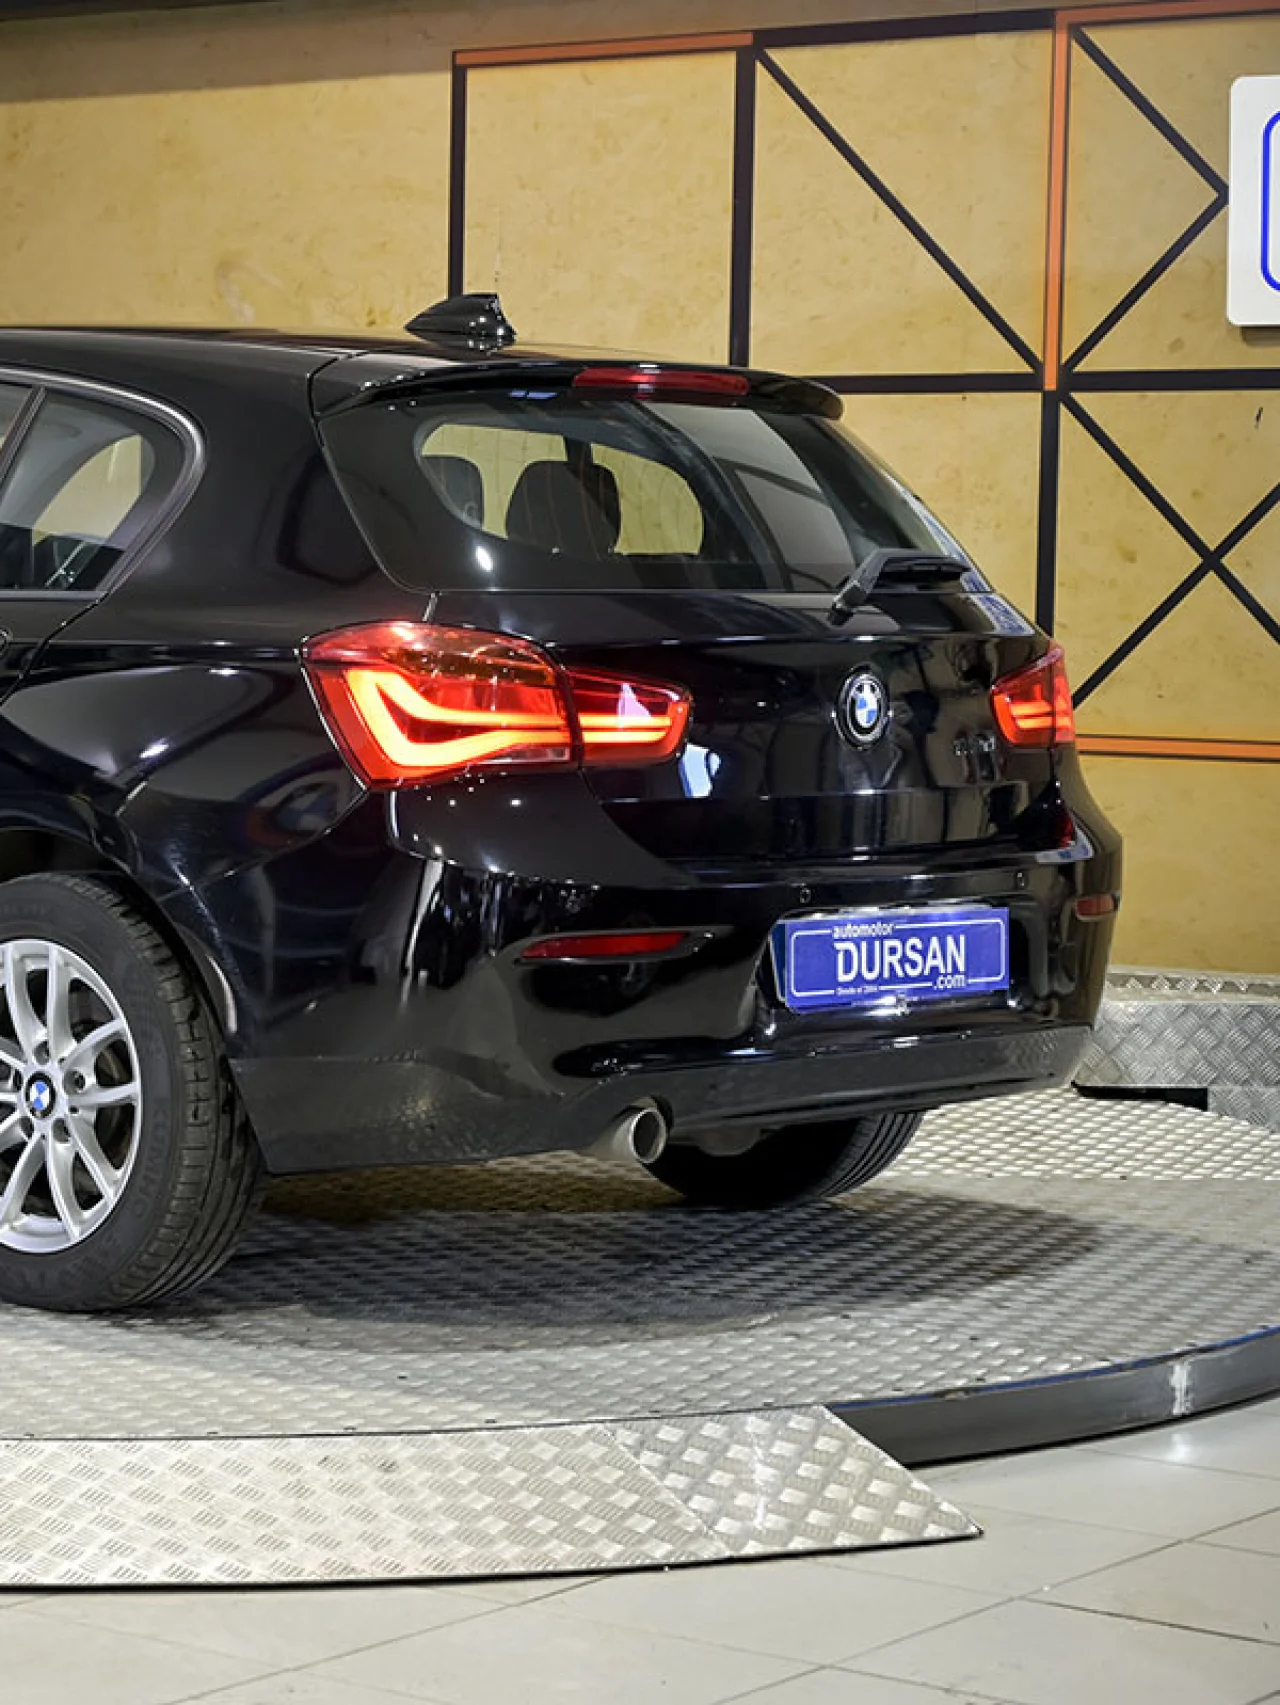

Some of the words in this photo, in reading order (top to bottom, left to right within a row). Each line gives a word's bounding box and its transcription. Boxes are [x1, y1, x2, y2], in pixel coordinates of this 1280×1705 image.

[832, 922, 894, 939] automotor
[834, 935, 965, 982] DURSAN
[933, 975, 965, 989] .com
